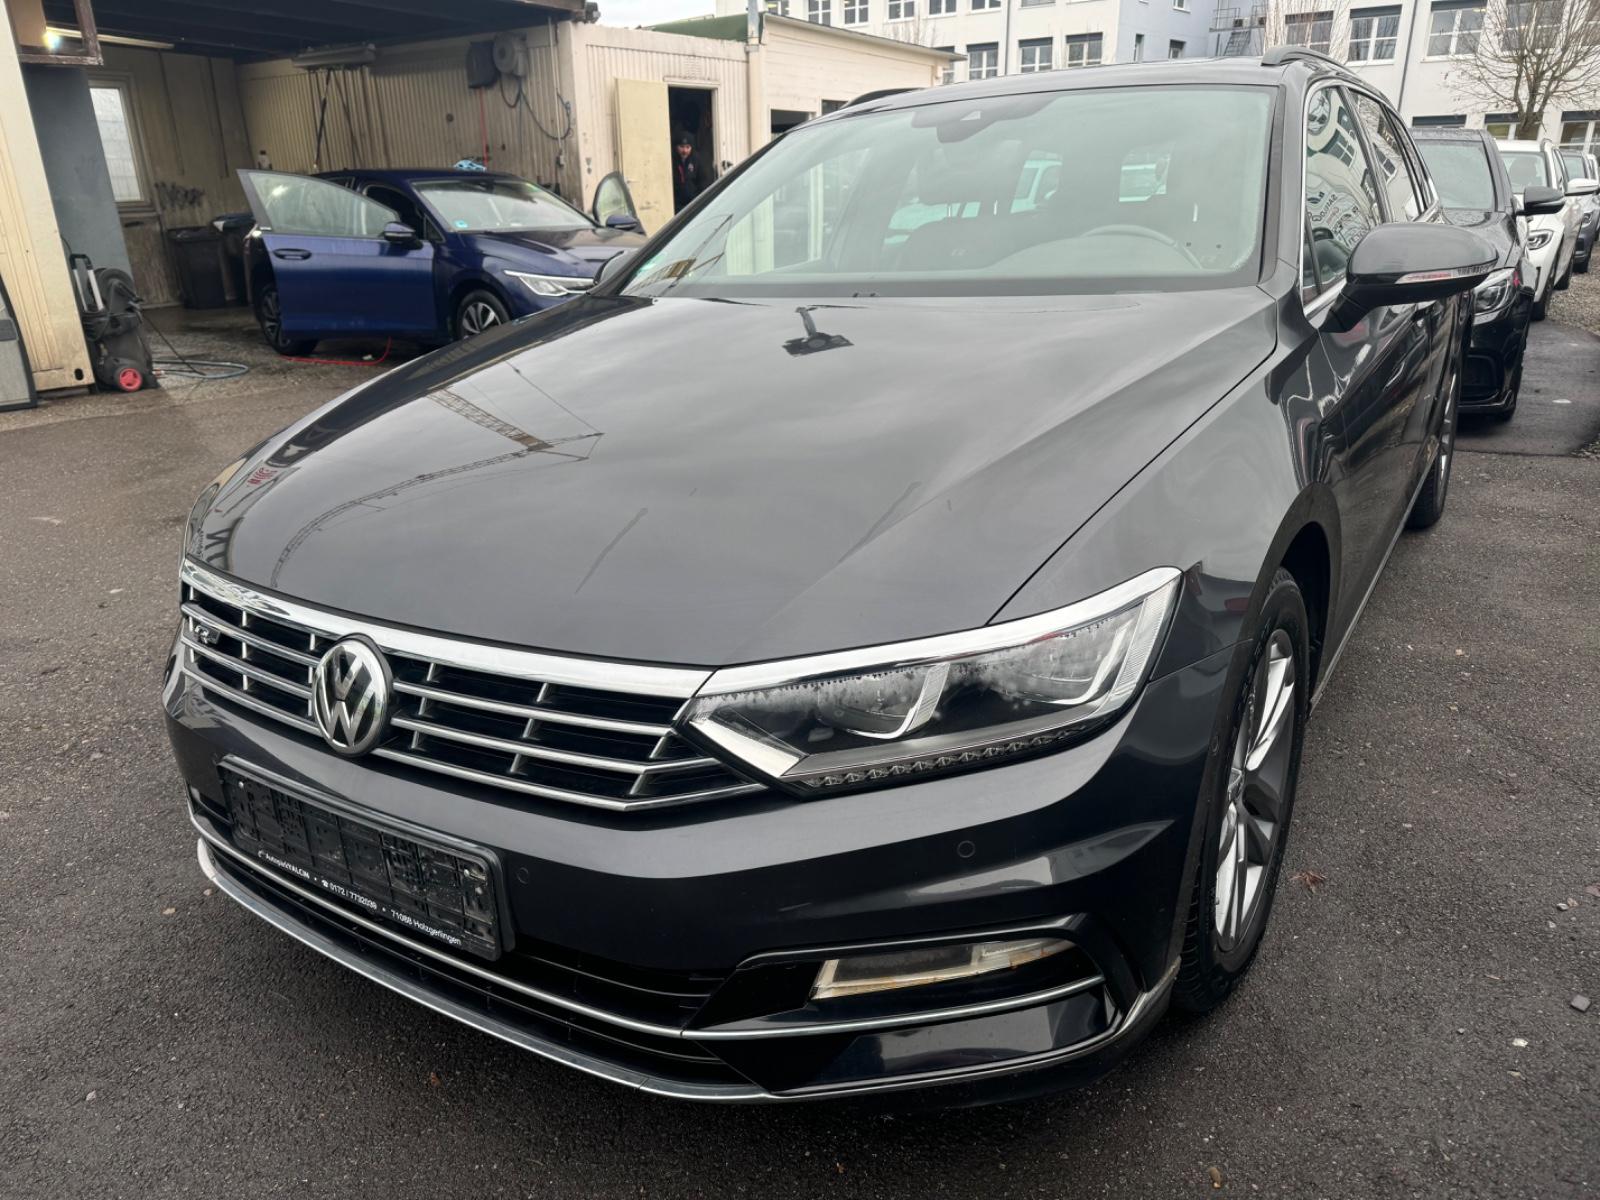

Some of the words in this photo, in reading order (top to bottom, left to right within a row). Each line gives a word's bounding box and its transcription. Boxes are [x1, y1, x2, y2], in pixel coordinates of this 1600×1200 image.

[315, 638, 387, 750] VW
[329, 882, 345, 896] 0172
[412, 917, 462, 946] Holzgerlingen
